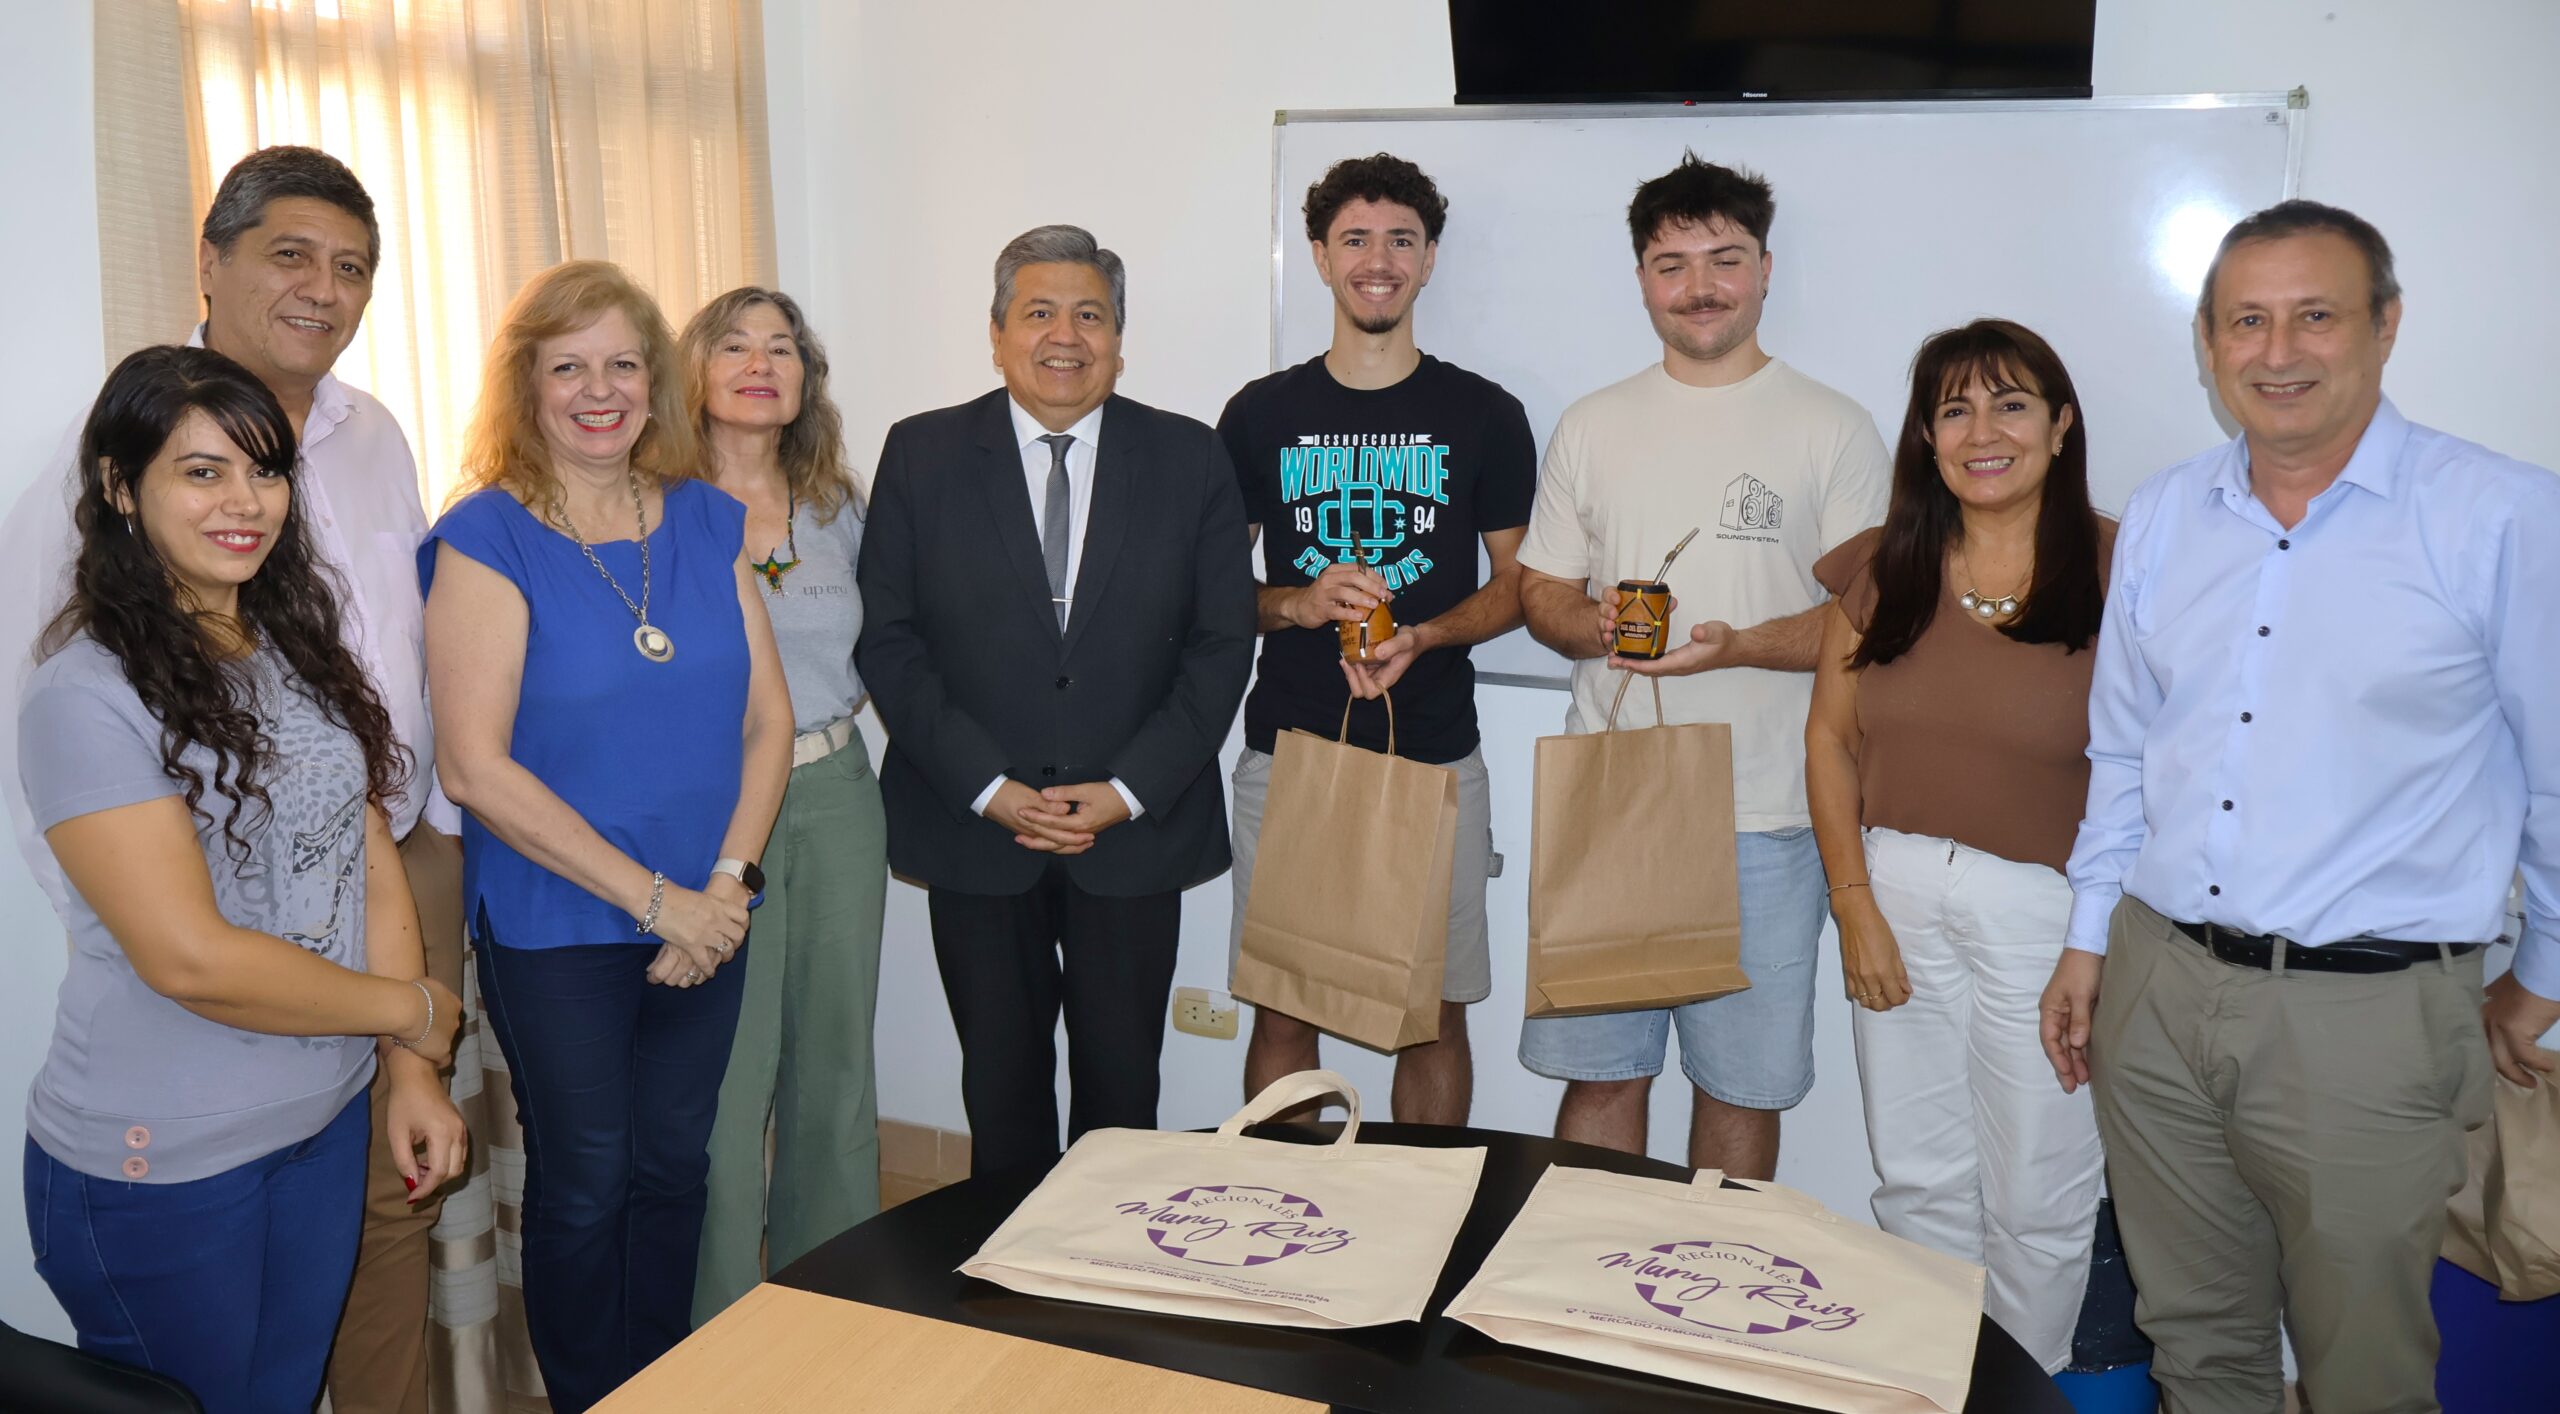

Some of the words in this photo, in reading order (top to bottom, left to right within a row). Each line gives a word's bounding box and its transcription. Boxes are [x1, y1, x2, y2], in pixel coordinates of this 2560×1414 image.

[1280, 445, 1449, 505] WORLDWIDE
[1295, 507, 1313, 533] 19
[1413, 506, 1436, 534] 94
[1715, 533, 1779, 544] SOUNDSYSTEM
[1191, 1195, 1299, 1220] REGIONALES
[1115, 1202, 1236, 1242] Mary
[1244, 1221, 1357, 1254] Ruiz
[1089, 1261, 1148, 1273] MERCADO
[1676, 1251, 1796, 1285] REGIONALES
[1597, 1252, 1729, 1301] Mary
[1739, 1285, 1865, 1331] Ruiz
[1589, 1314, 1653, 1329] MERCADO
